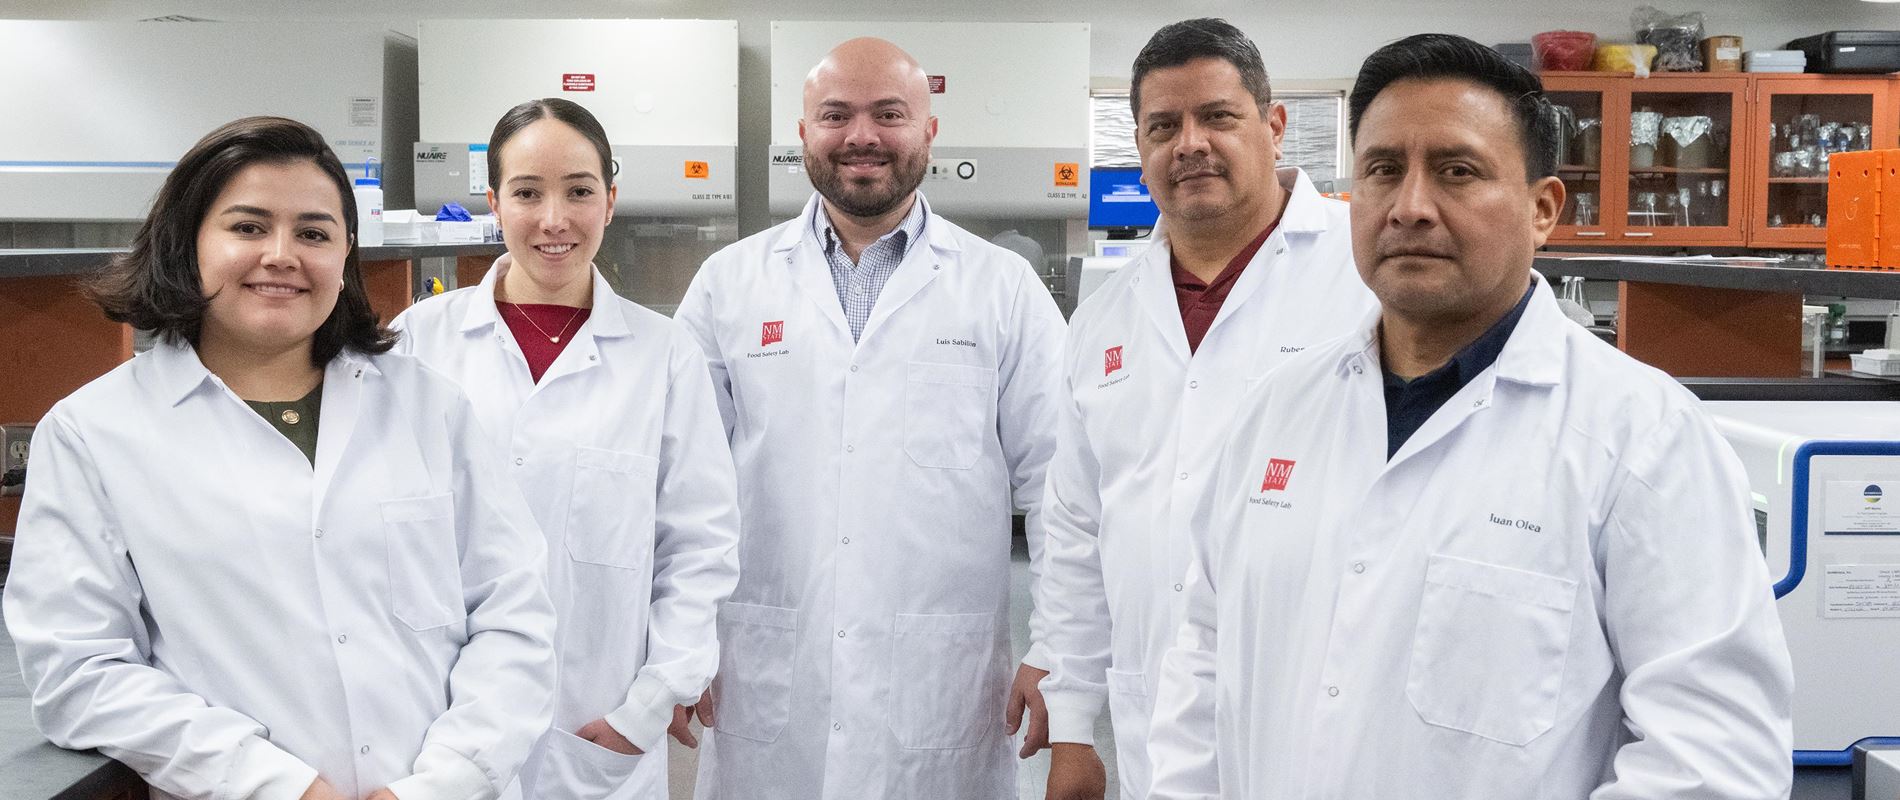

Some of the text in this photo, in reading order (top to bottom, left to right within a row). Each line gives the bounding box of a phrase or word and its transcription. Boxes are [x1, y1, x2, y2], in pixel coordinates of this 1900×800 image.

[416, 152, 447, 160] NUAIRE
[772, 155, 803, 163] NUAIRE
[763, 323, 783, 335] NM
[1105, 349, 1122, 363] NM
[1266, 462, 1293, 478] NM
[1261, 498, 1279, 508] Safety
[1280, 501, 1292, 510] Lab
[1489, 512, 1542, 533] Juan Olea
